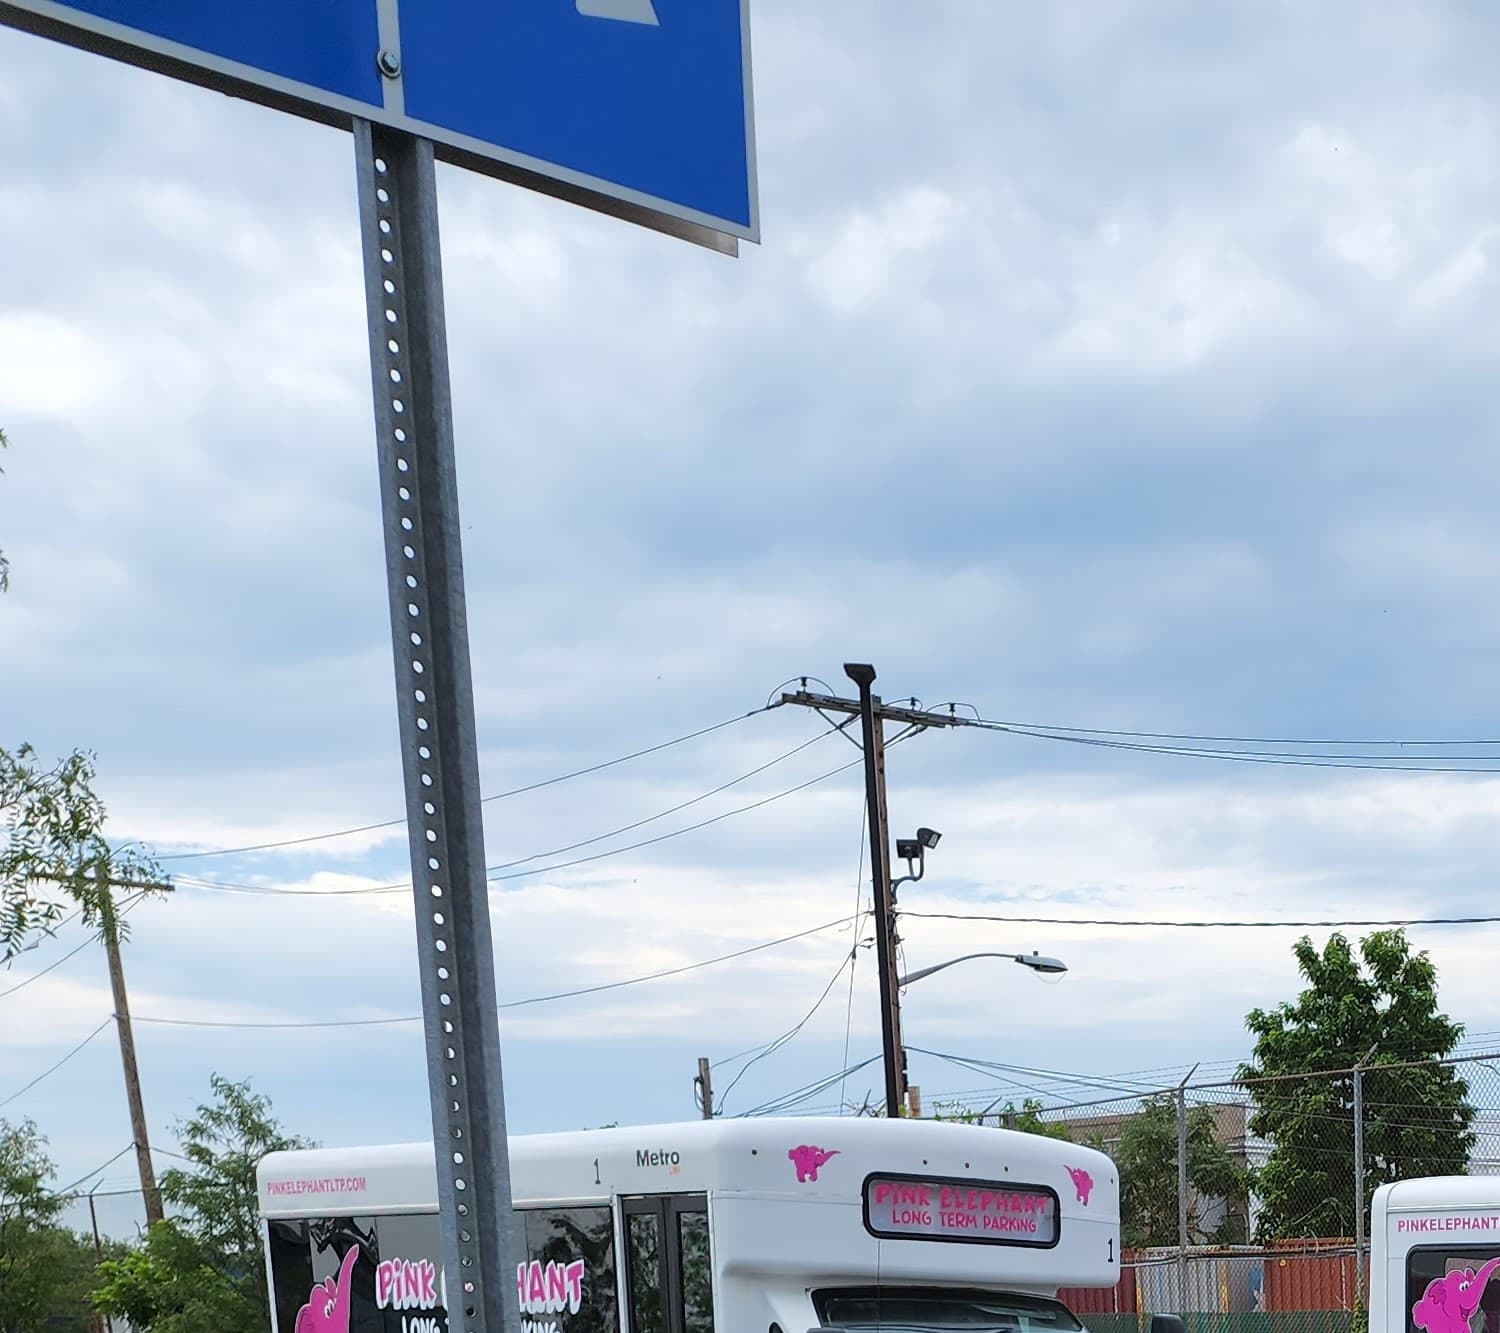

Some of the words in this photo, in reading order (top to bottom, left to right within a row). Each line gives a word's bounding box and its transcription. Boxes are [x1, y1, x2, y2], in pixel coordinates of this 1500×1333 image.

[636, 1148, 680, 1167] Metro
[593, 1157, 601, 1185] 1
[267, 1177, 367, 1196] PINKELEPHANTLTP.COM
[939, 1189, 1050, 1214] ELEPHANT
[892, 1211, 932, 1226] LONG
[938, 1211, 978, 1229] TERM
[983, 1216, 1037, 1233] PARKING
[1107, 1238, 1114, 1263] 1
